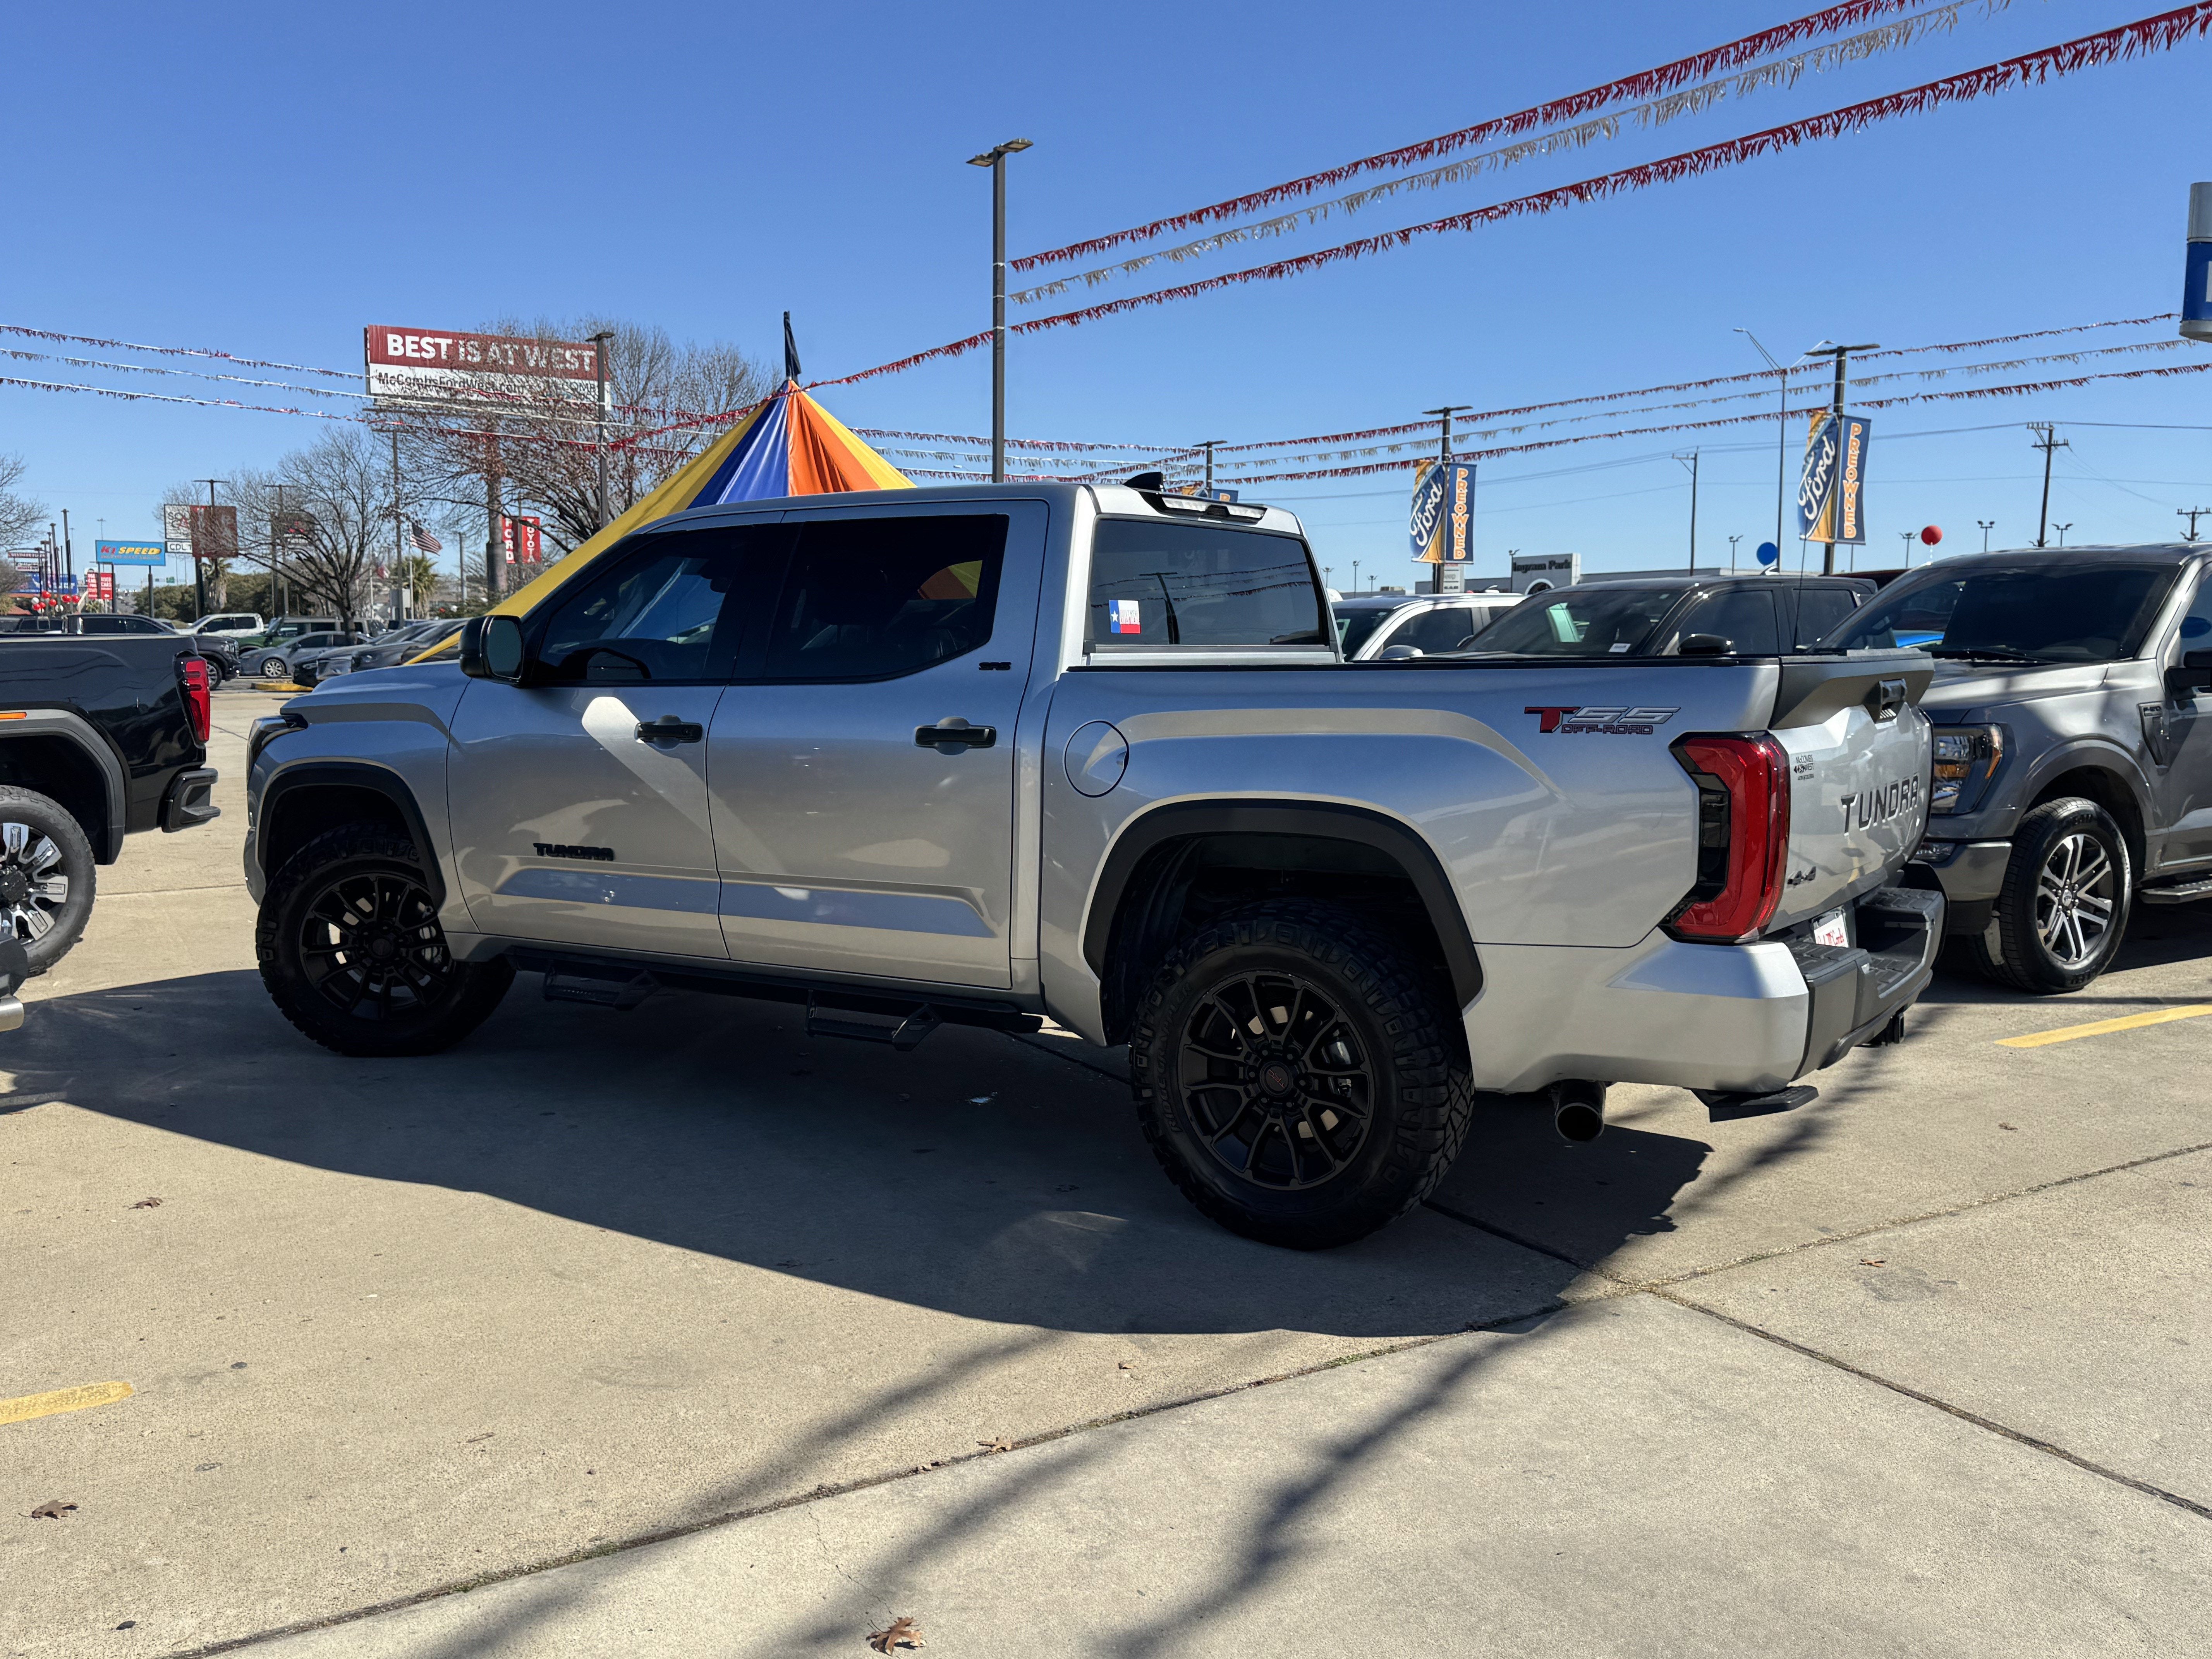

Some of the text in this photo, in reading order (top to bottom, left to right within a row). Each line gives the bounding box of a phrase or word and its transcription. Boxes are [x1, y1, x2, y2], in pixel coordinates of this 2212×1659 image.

[387, 333, 596, 372] BEST IS AT WEST
[1797, 435, 1836, 520] Ford
[1843, 422, 1862, 539] PREOWNED
[1410, 479, 1443, 546] Ford
[1451, 467, 1469, 560] PREOWNED
[100, 545, 161, 555] K1 SPEED
[504, 518, 514, 560] FORD
[526, 518, 535, 562] TOYOTA
[1513, 560, 1571, 574] Ingram Park
[1561, 724, 1654, 735] OFF-ROAD
[1841, 772, 1920, 836] TUNDRA
[533, 843, 614, 861] TUNDRA
